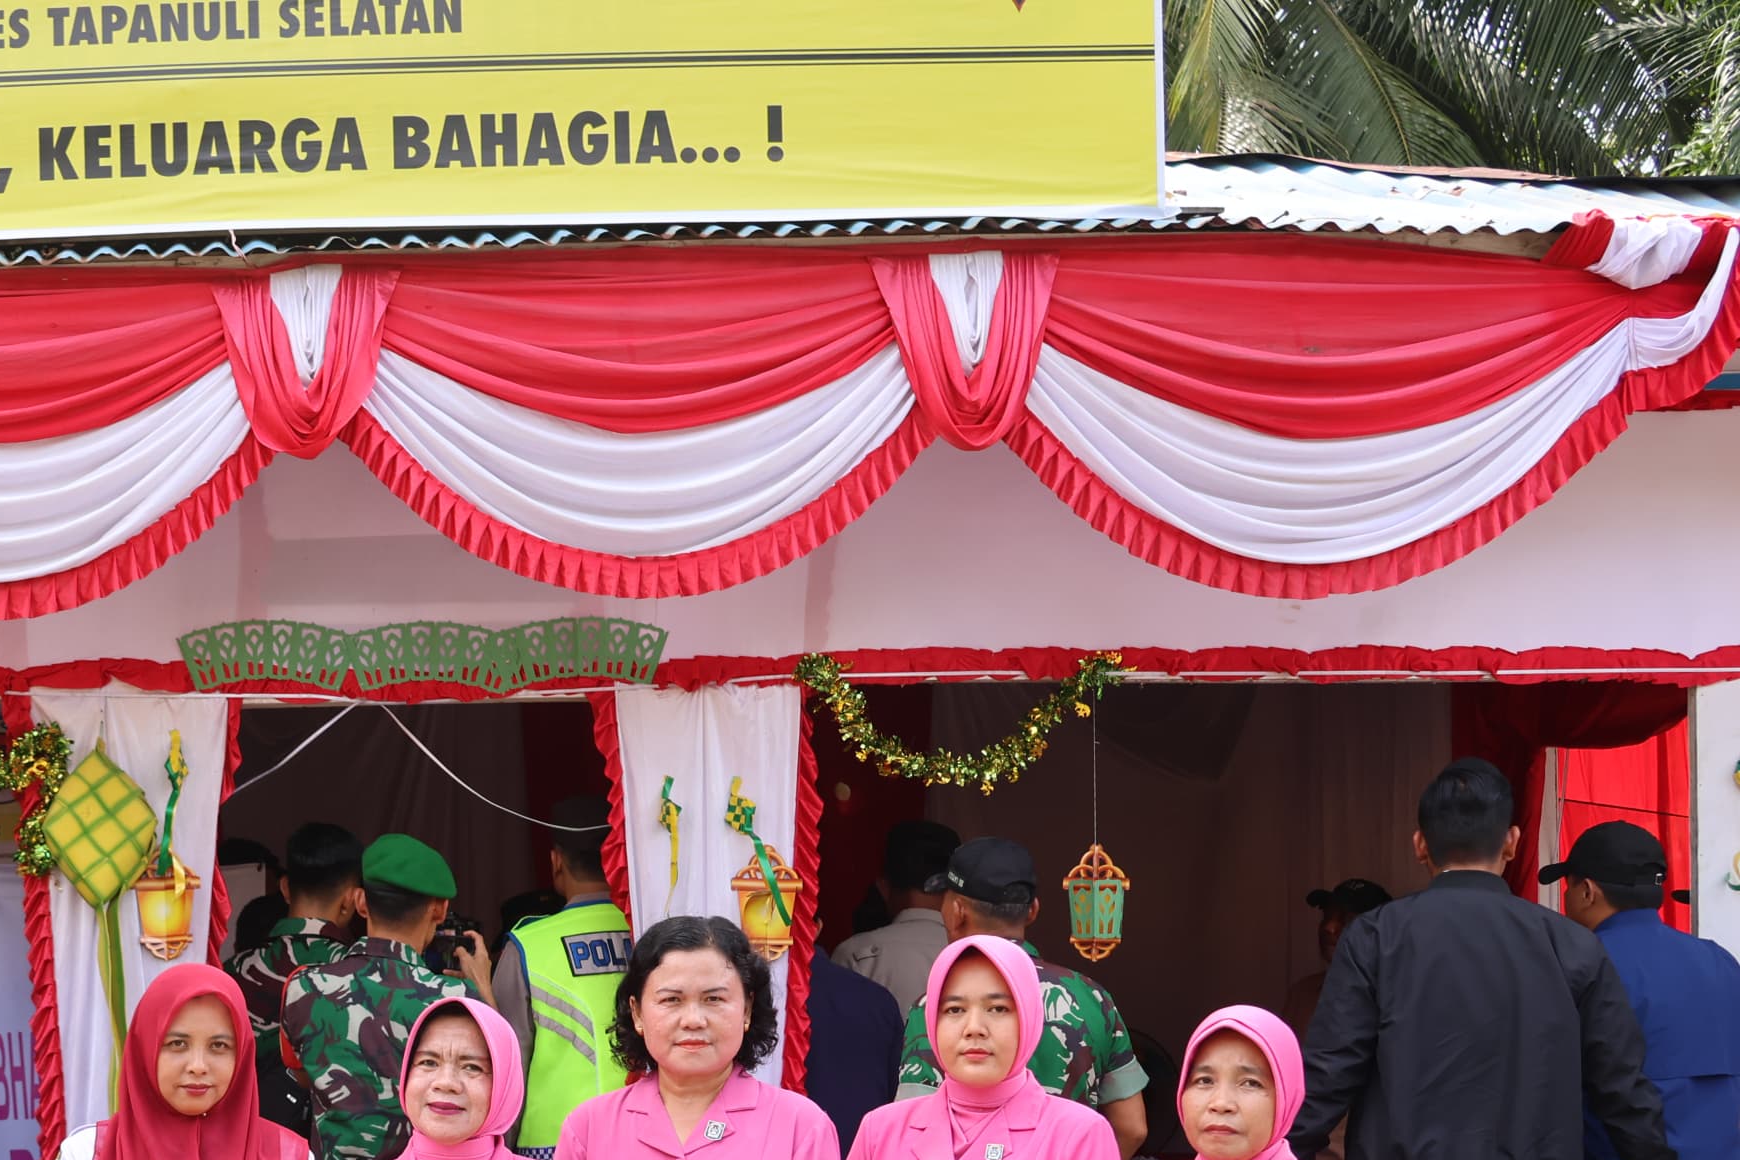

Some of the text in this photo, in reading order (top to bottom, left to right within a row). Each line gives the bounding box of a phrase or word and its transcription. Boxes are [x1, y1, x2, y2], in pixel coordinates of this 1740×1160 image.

[48, 1, 260, 50] TAPANULI
[279, 0, 463, 38] SELATAN
[38, 117, 369, 182] KELUARGA
[392, 110, 741, 170] BAHAGIA...
